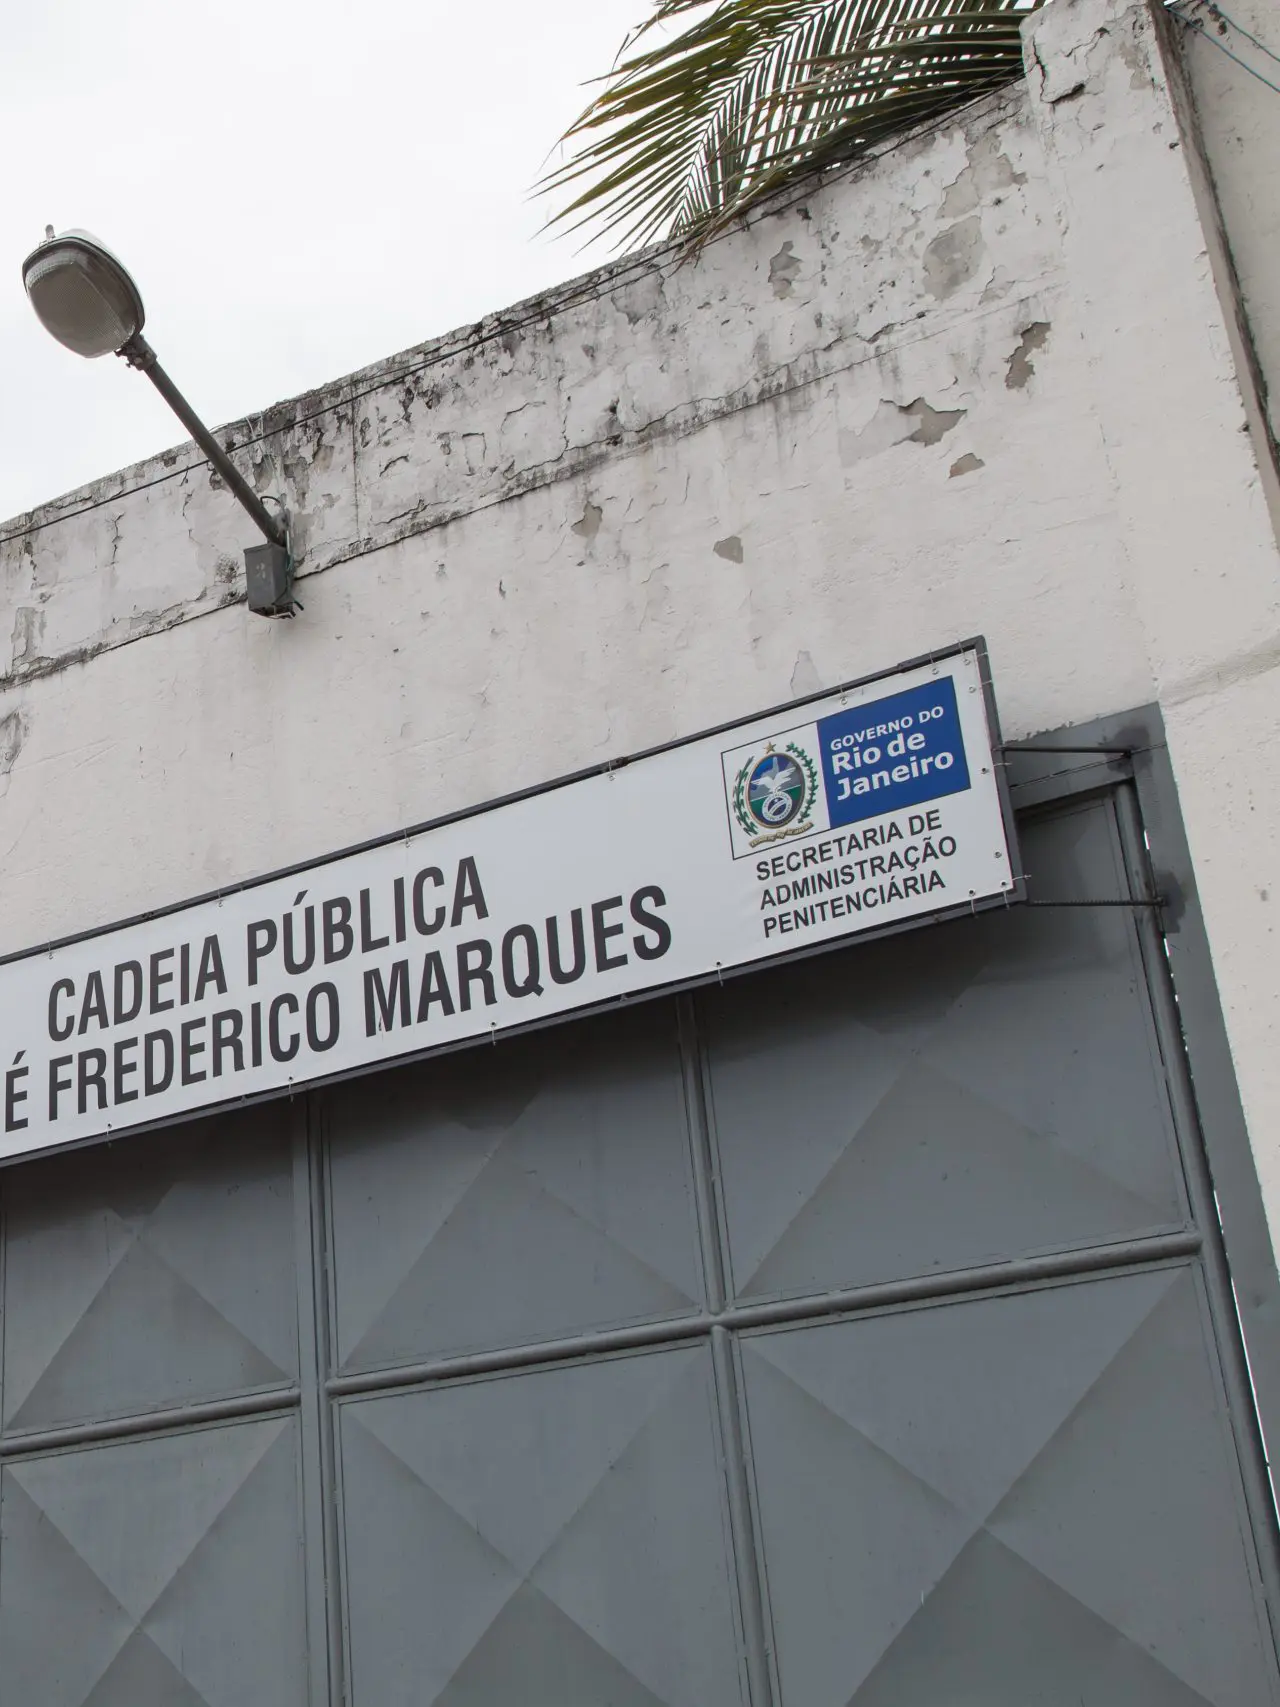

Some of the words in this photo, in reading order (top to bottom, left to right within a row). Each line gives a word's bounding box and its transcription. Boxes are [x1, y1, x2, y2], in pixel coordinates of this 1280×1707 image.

[830, 716, 913, 751] GOVERNO
[919, 706, 944, 724] DO
[831, 747, 881, 775] Rio
[887, 731, 926, 757] de
[836, 751, 954, 801] Janeiro
[756, 821, 903, 881] SECRETARIA
[908, 809, 942, 837] DE
[760, 835, 957, 910] ADMINISTRAÇÃO
[763, 870, 946, 938] PENITENCIÁRIA
[48, 934, 228, 1042] CADEIA
[247, 855, 489, 987] PÚBLICA
[48, 981, 340, 1122] FREDERICO
[363, 885, 672, 1038] MARQUES
